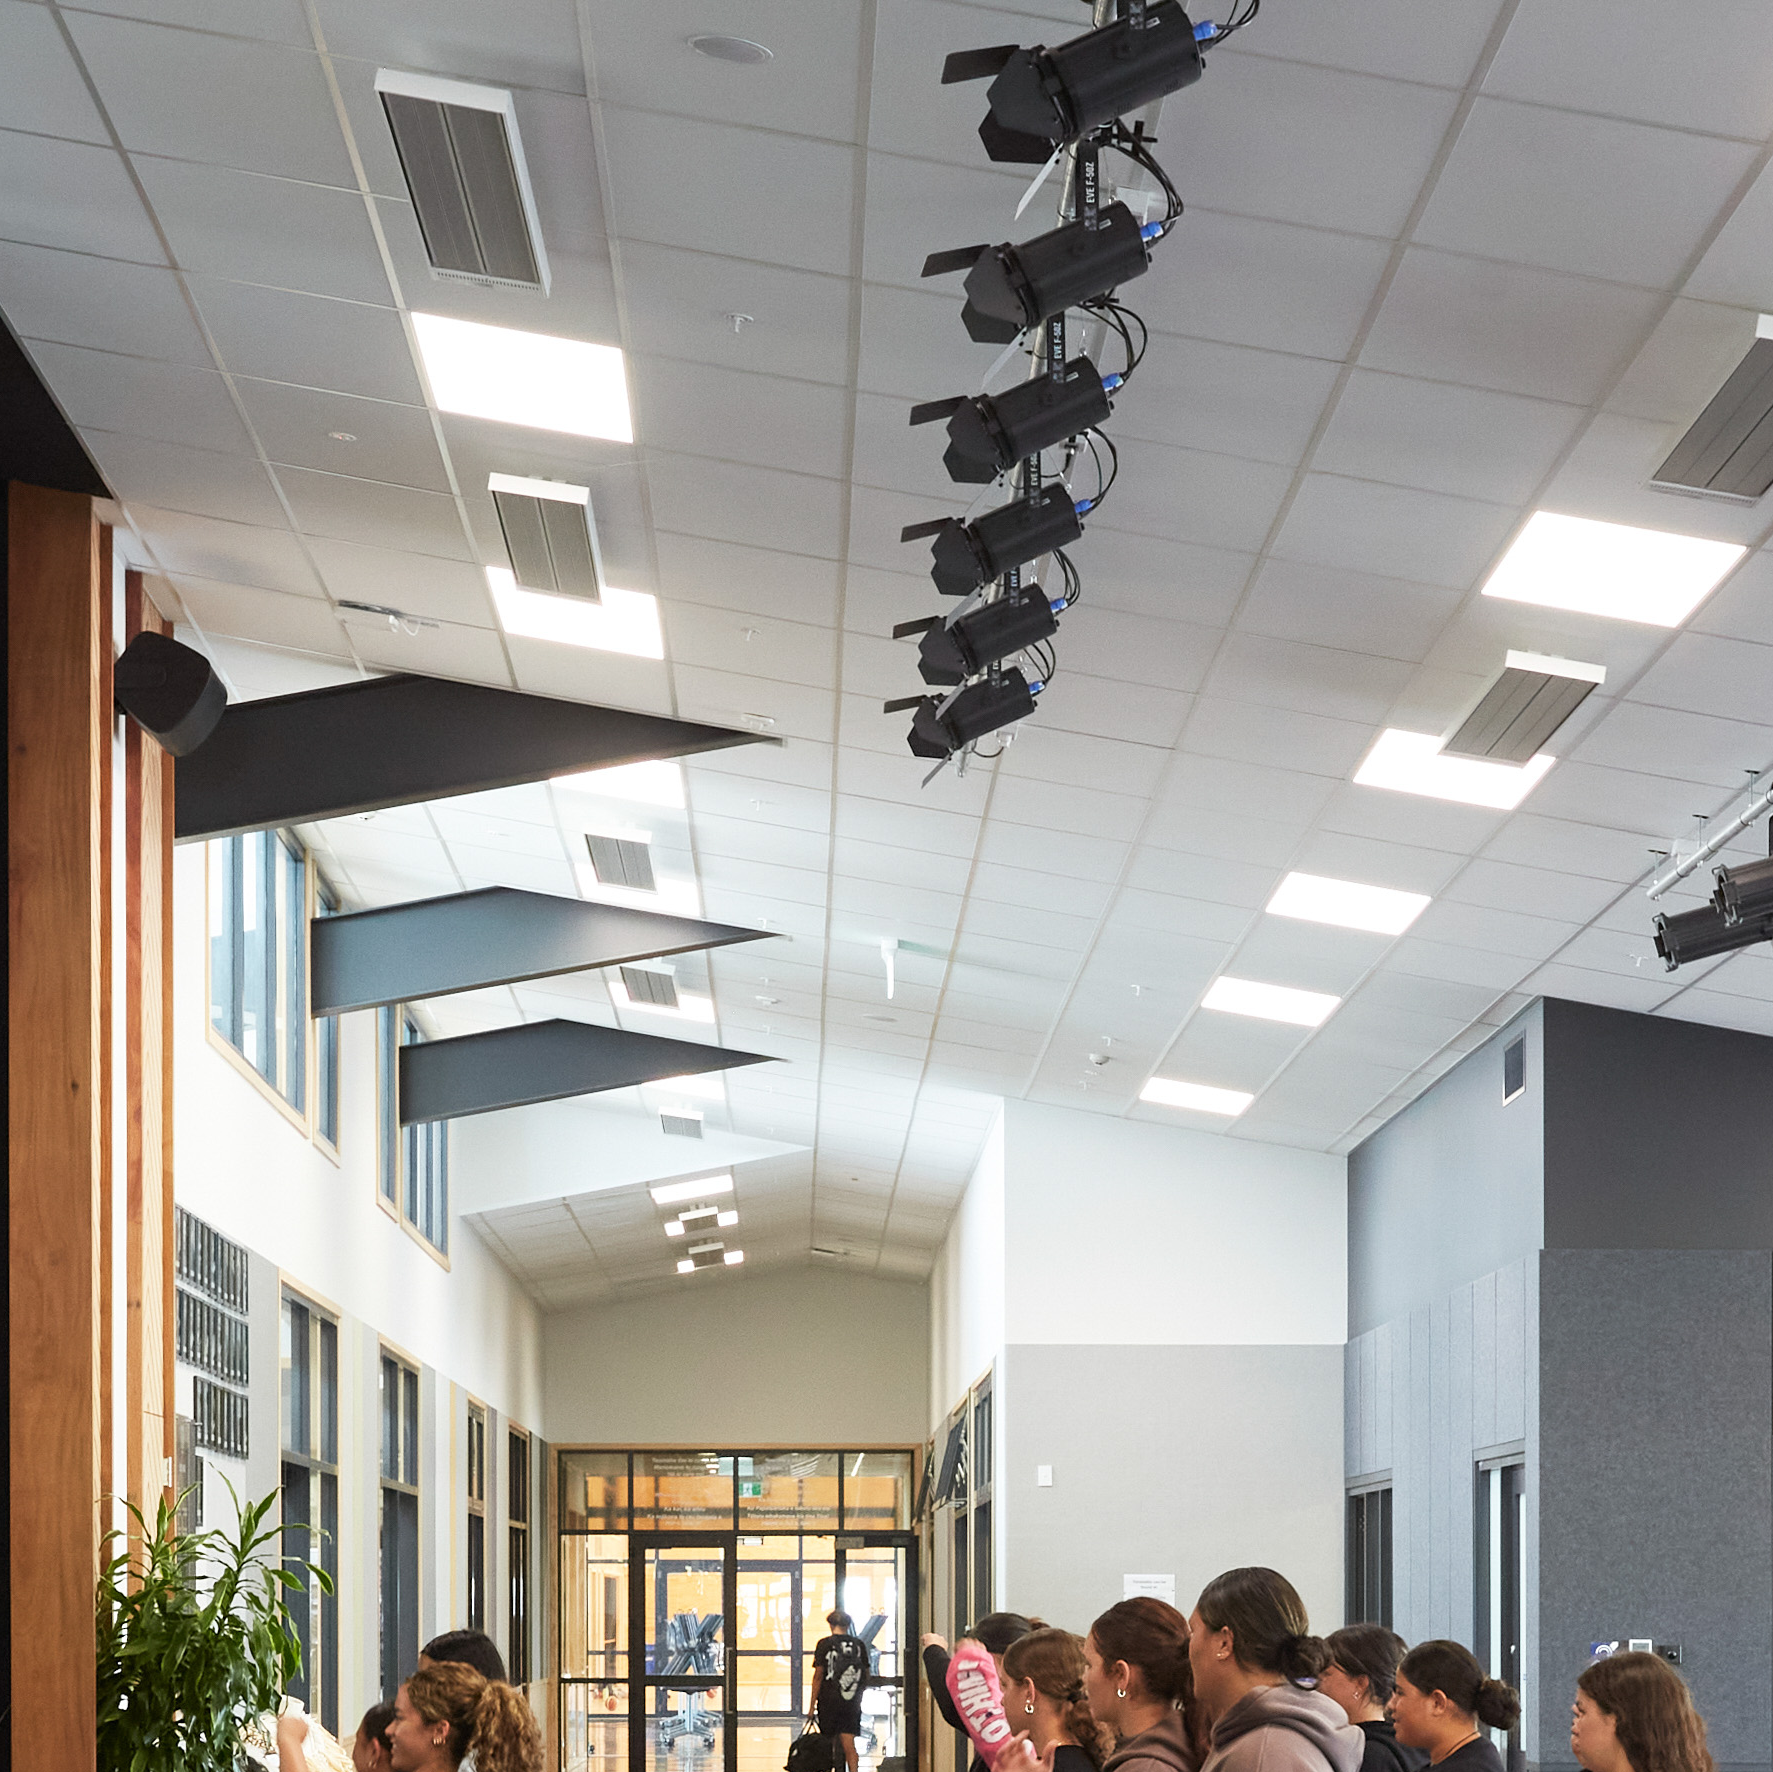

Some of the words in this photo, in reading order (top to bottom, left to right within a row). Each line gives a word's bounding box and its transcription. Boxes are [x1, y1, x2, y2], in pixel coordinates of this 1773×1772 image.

[1085, 161, 1095, 185] F-50Z
[1085, 187, 1095, 203] EVE
[1053, 344, 1062, 359] EVE
